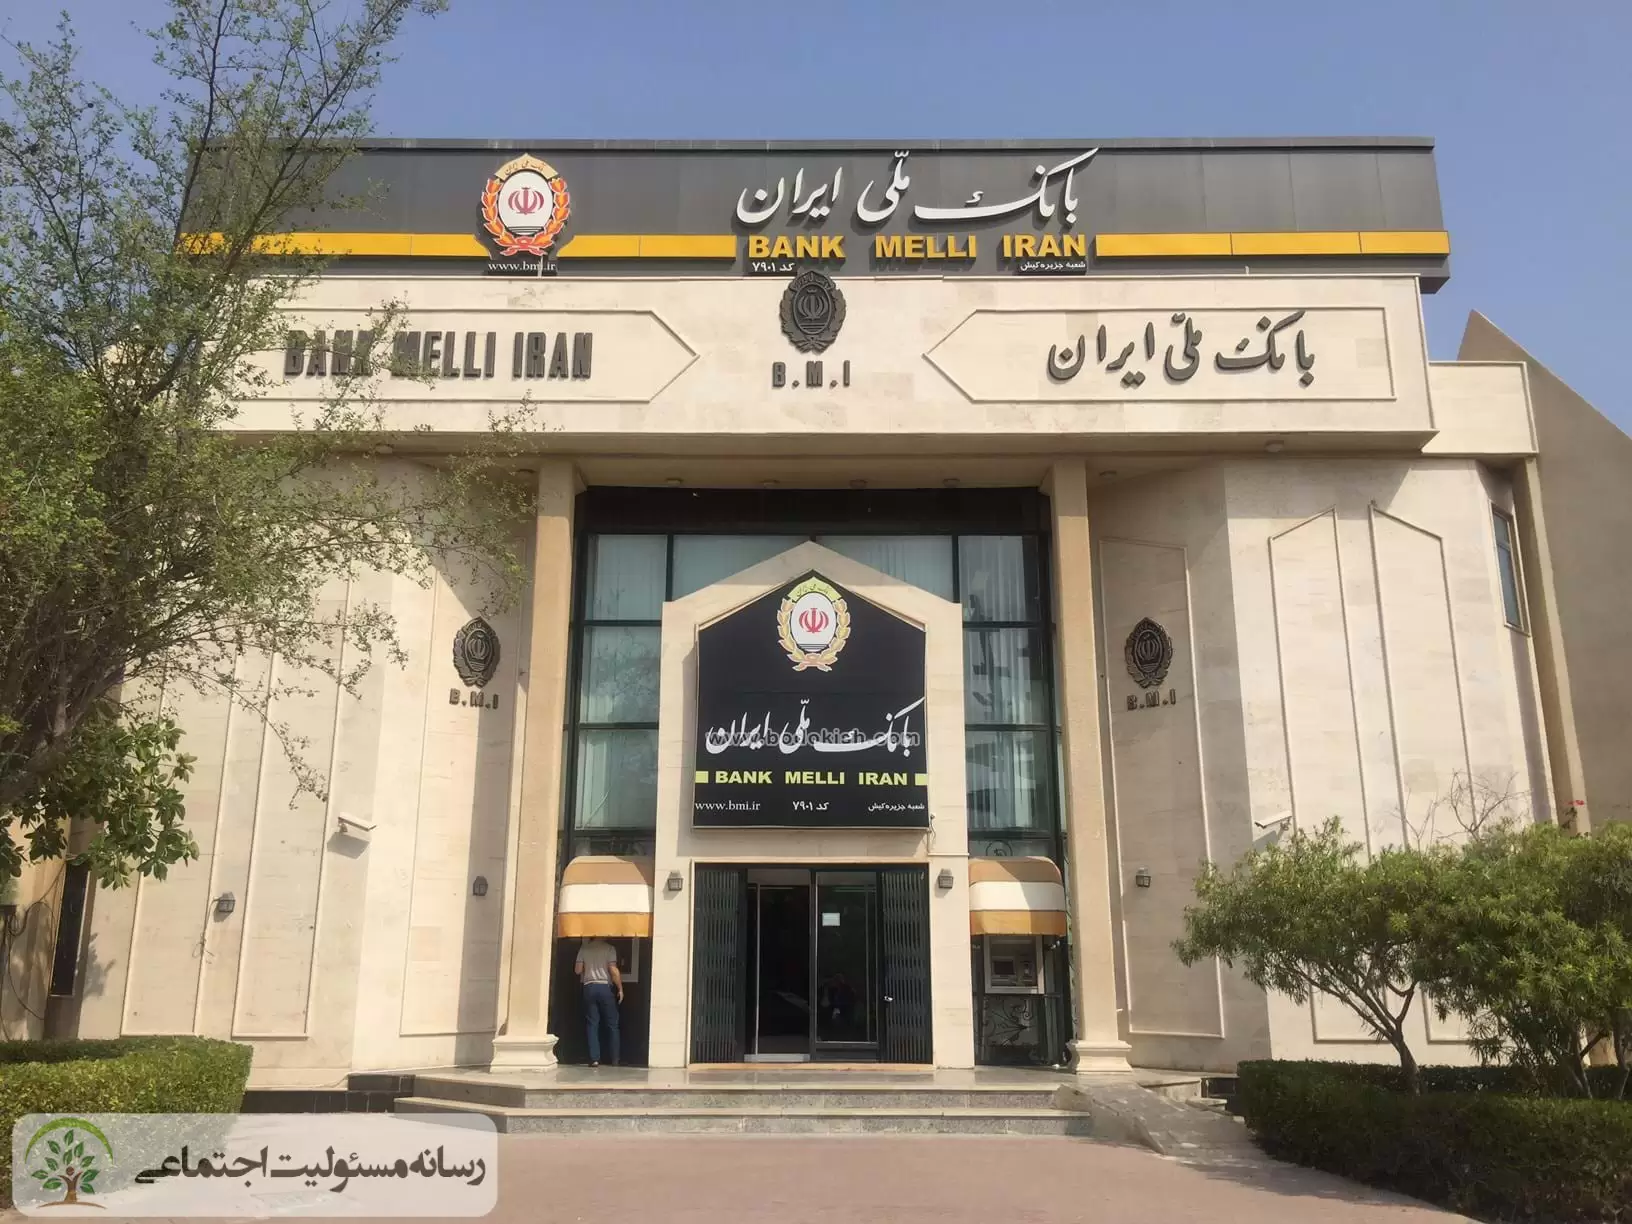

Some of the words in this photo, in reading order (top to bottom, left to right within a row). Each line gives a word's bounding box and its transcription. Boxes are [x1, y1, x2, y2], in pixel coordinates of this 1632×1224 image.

[736, 167, 842, 223] ایران
[748, 235, 846, 258] BANK
[875, 235, 977, 258] MELLI
[1003, 234, 1086, 257] IRAN
[780, 262, 795, 271] کد
[513, 332, 593, 378] IRAN
[1048, 321, 1156, 386] ایران
[706, 712, 771, 754] ایران
[715, 771, 772, 784] BANK
[785, 772, 845, 785] MELLI
[858, 773, 908, 785] IRAN
[695, 800, 761, 810] www.bmi.ir
[816, 802, 829, 811] کد
